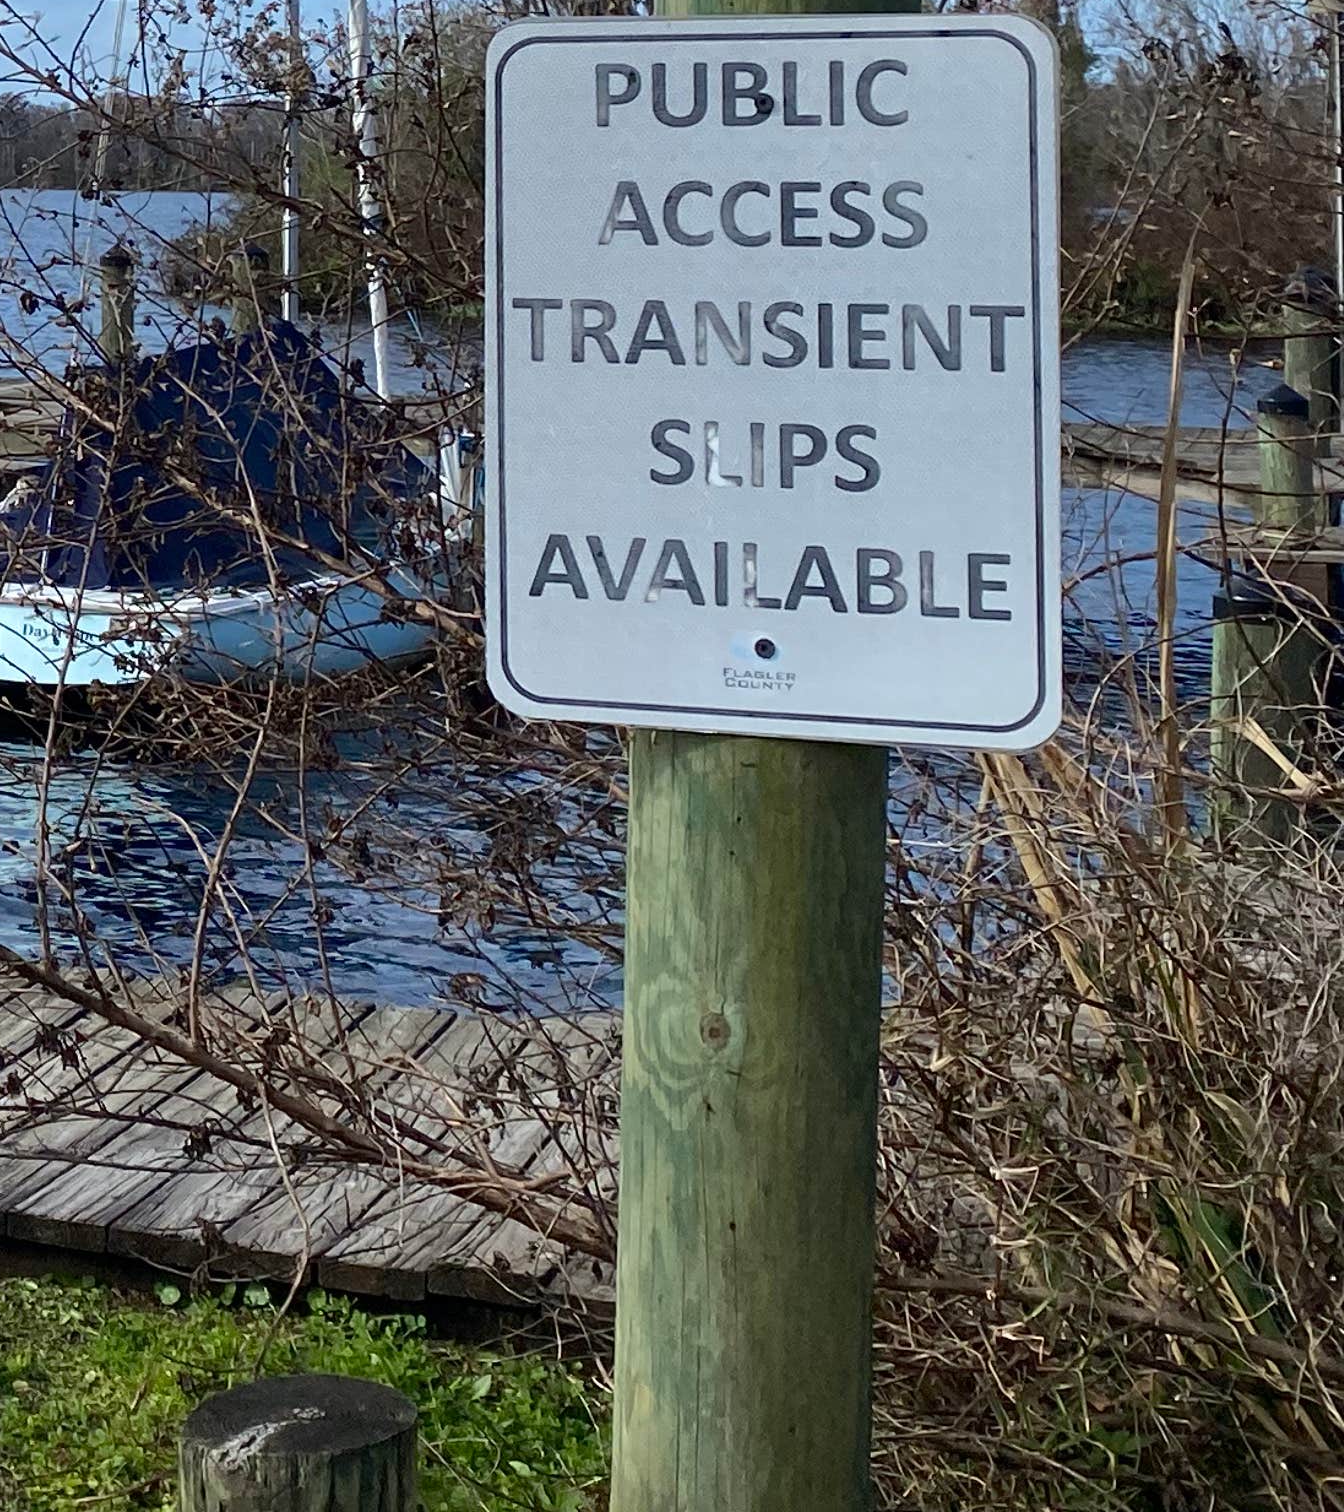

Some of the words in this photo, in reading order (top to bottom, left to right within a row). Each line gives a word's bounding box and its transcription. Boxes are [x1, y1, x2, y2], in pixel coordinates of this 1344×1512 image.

[594, 60, 909, 128] PUBLIC
[597, 180, 930, 248] ACCESS
[511, 297, 1026, 373] TRANSIENT
[649, 418, 882, 492] SLIPS
[528, 533, 1013, 622] AVAILABLE
[722, 667, 797, 682] FLAGLER
[724, 677, 795, 692] COUNTY
